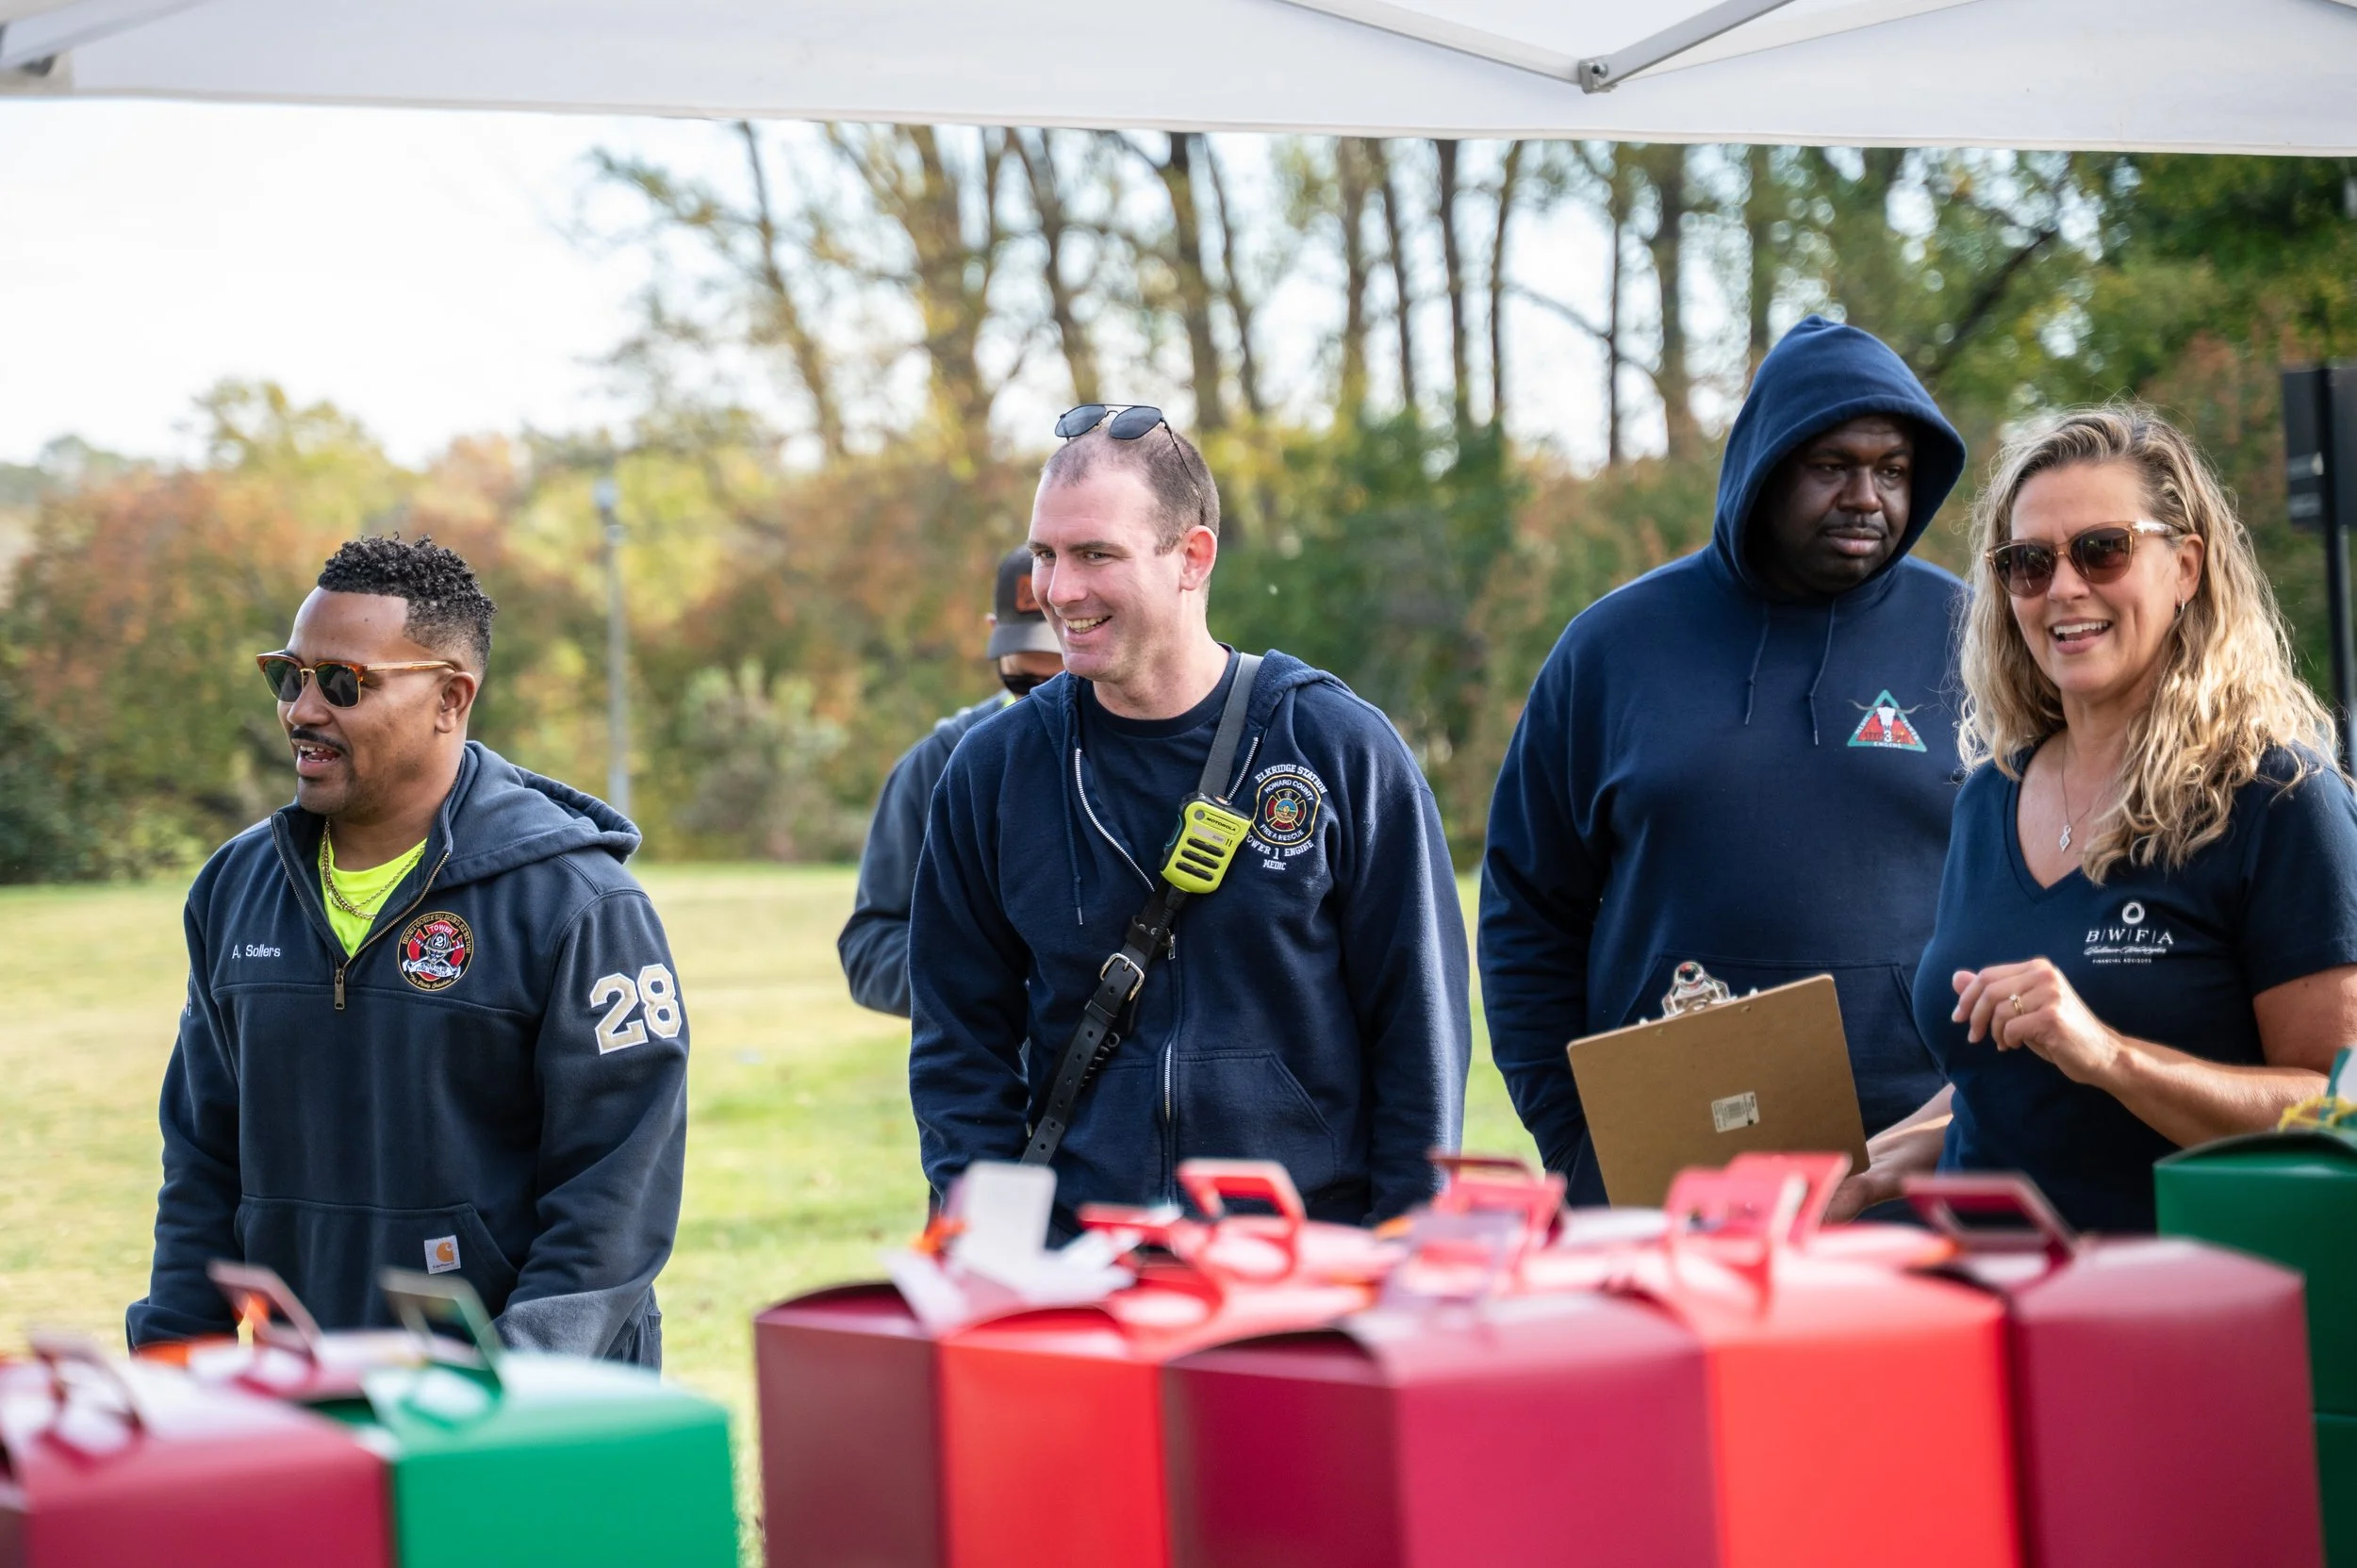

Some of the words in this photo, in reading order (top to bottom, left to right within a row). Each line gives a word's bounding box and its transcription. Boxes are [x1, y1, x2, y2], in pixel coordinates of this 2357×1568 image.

[1884, 730, 1892, 742] 3
[1255, 764, 1296, 784] ELKRIDGE
[1297, 766, 1327, 794] STATION
[1264, 780, 1292, 794] HOWARD
[1293, 781, 1314, 801] COUNTY
[1206, 817, 1236, 832] MOTOROLA
[1260, 823, 1273, 836] FIRE
[1277, 830, 1304, 840] RESCUE
[1247, 832, 1272, 854] TOWER
[1273, 848, 1279, 859] 1
[1284, 839, 1314, 857] ENGINE
[1262, 859, 1287, 870] MEDIC
[429, 924, 453, 935] TOWER
[434, 935, 444, 947] 2
[245, 943, 281, 957] Sollers
[589, 963, 683, 1055] 28
